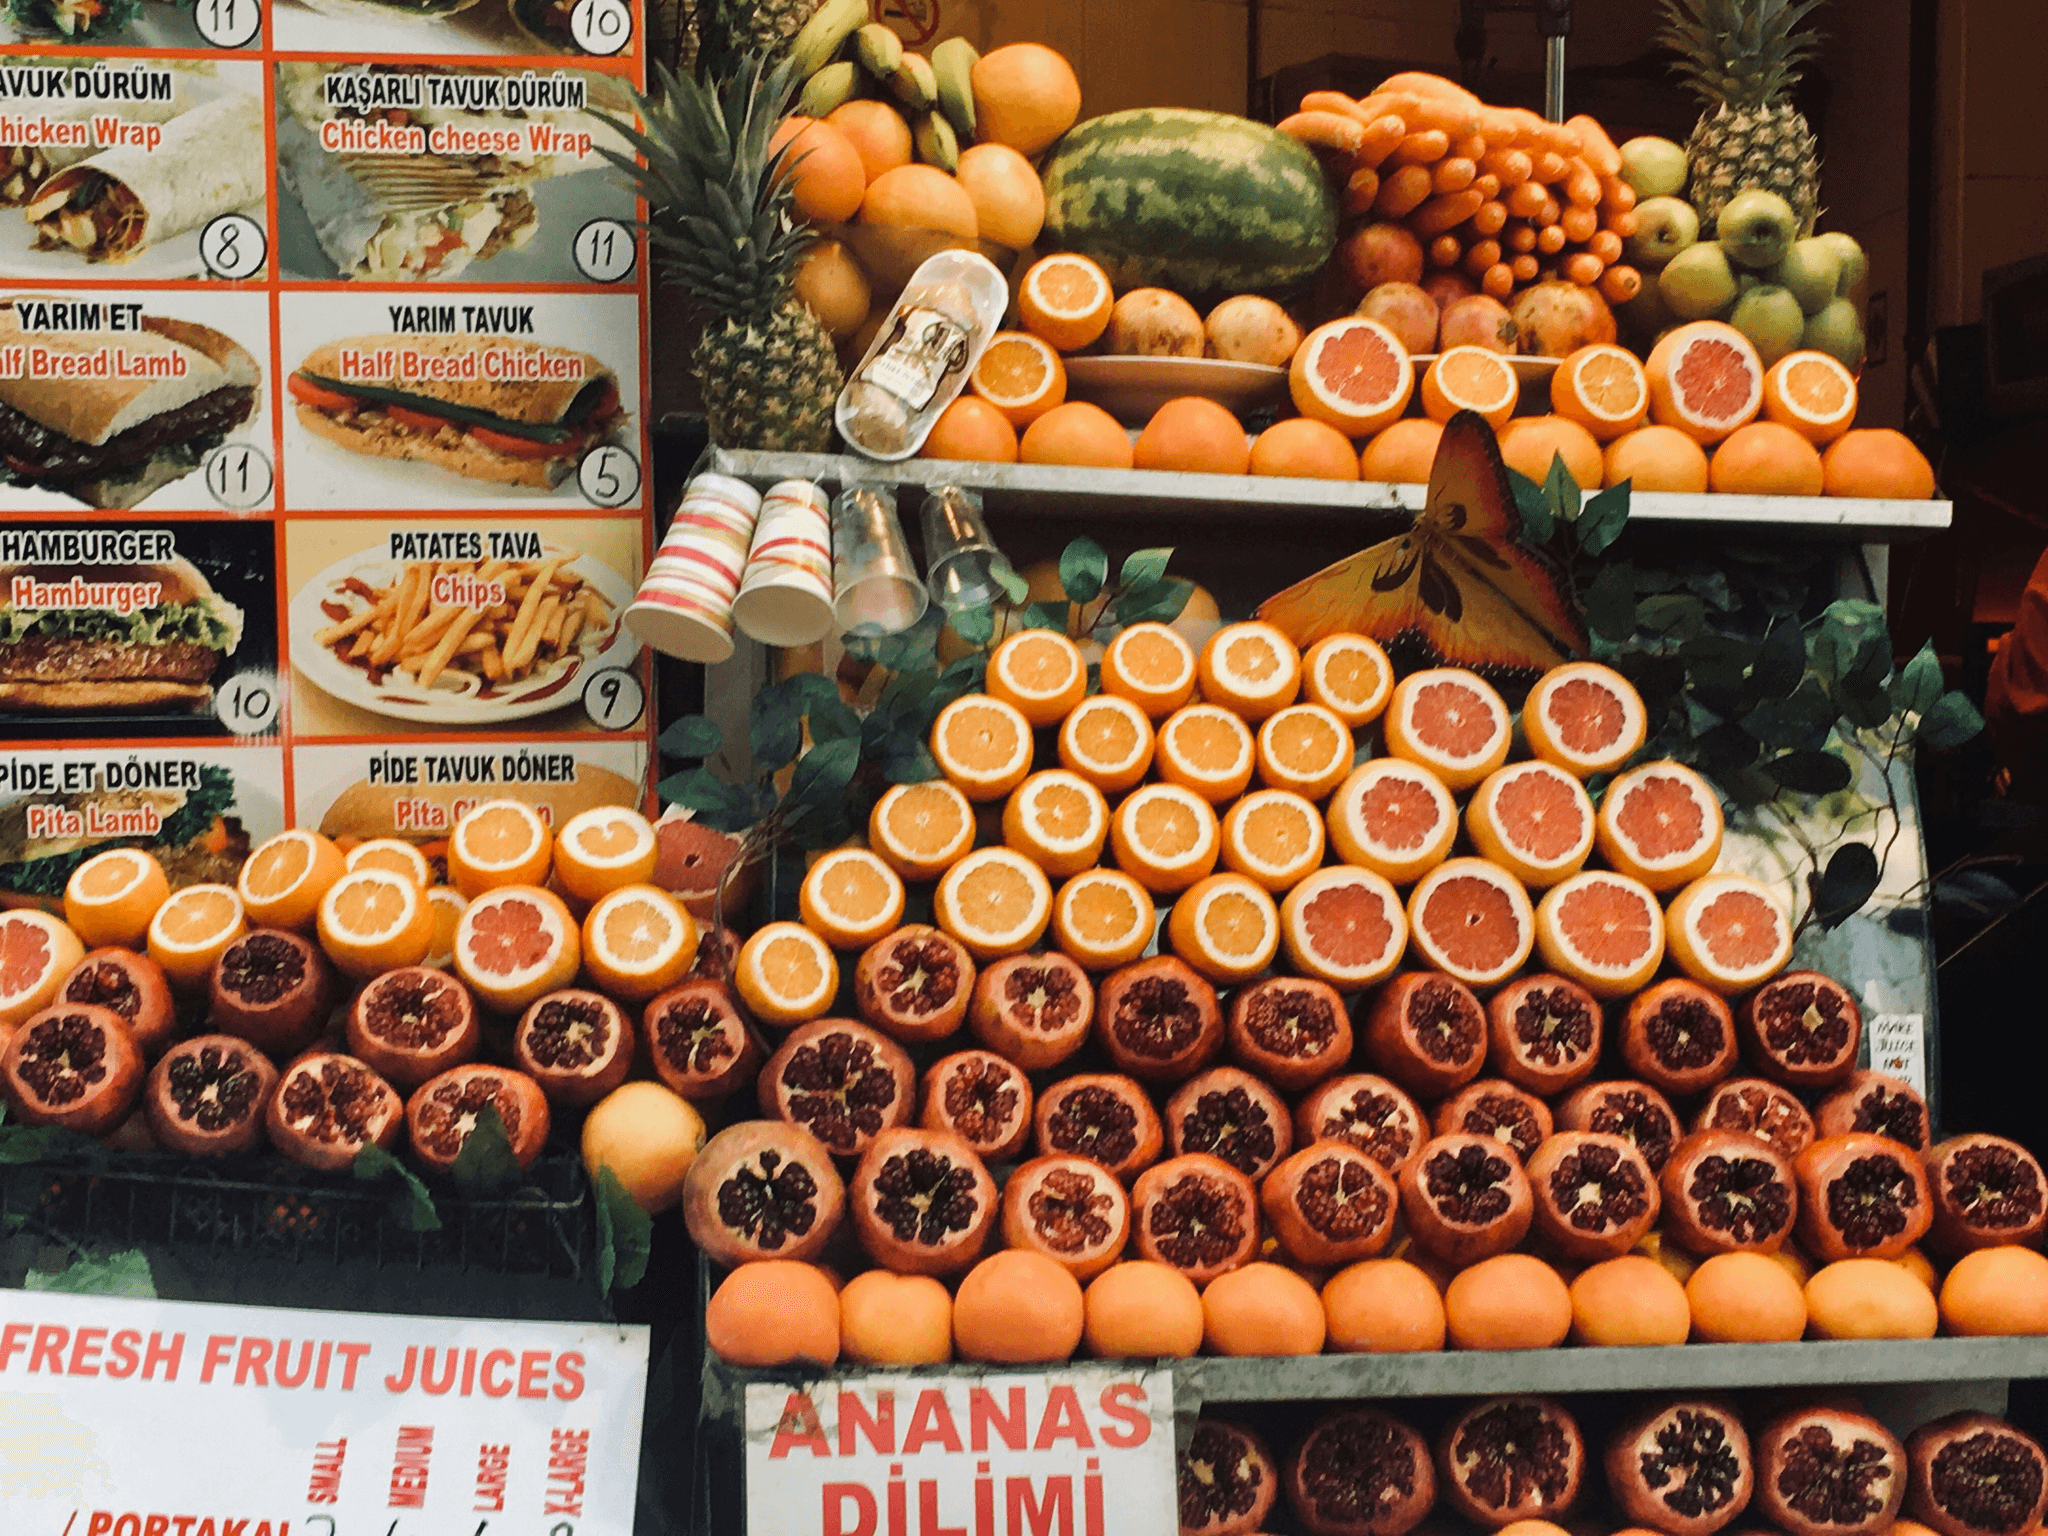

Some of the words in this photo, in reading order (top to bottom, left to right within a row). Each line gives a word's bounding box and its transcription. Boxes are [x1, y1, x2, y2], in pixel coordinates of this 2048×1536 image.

[209, 0, 235, 32] 11
[586, 0, 621, 38] 10
[75, 65, 172, 100] DÜRÜM
[327, 76, 420, 111] KAŞARLI
[428, 78, 501, 107] TAVUK
[507, 74, 584, 107] DÜRÜM
[95, 117, 161, 151] Wrap
[322, 122, 423, 150] Chicken
[431, 124, 521, 152] cheese
[529, 125, 592, 158] Wrap
[216, 223, 239, 269] 8
[591, 228, 615, 267] 11
[17, 303, 100, 331] YARIM
[110, 304, 143, 331] ET
[388, 305, 456, 333] YARIM
[462, 306, 534, 334] TAVUK
[0, 349, 22, 375] lf
[32, 349, 108, 376] Bread
[117, 349, 187, 377] Lamb
[342, 350, 393, 378] Half
[403, 351, 475, 379] Bread
[484, 351, 582, 380] Chicken
[218, 451, 249, 494] 11
[595, 452, 620, 498] 5
[2, 534, 173, 562] HAMBURGER
[390, 532, 481, 560] PATATES
[488, 532, 543, 560] TAVA
[15, 579, 157, 613] Hamburger
[433, 575, 504, 609] Chips
[232, 684, 270, 719] 10
[600, 677, 621, 719] 9
[63, 762, 96, 789] ET
[106, 754, 197, 788] DÖNER
[369, 749, 418, 783] PİDE
[424, 755, 495, 783] TAVUK
[502, 748, 575, 782] DÖNER
[30, 808, 80, 834] Pita
[89, 806, 160, 834] Lamb
[396, 800, 445, 826] Pita
[0, 1322, 187, 1381] FRESH
[198, 1333, 372, 1391] FRUIT
[384, 1344, 586, 1401] JUICES
[768, 1382, 1152, 1460] ANANAS
[306, 1436, 347, 1505] SMALL
[386, 1425, 435, 1508] MEDIUM
[473, 1442, 511, 1512] LARGE
[543, 1428, 590, 1517] X-LARGE
[822, 1457, 1106, 1536] DİLİMİ
